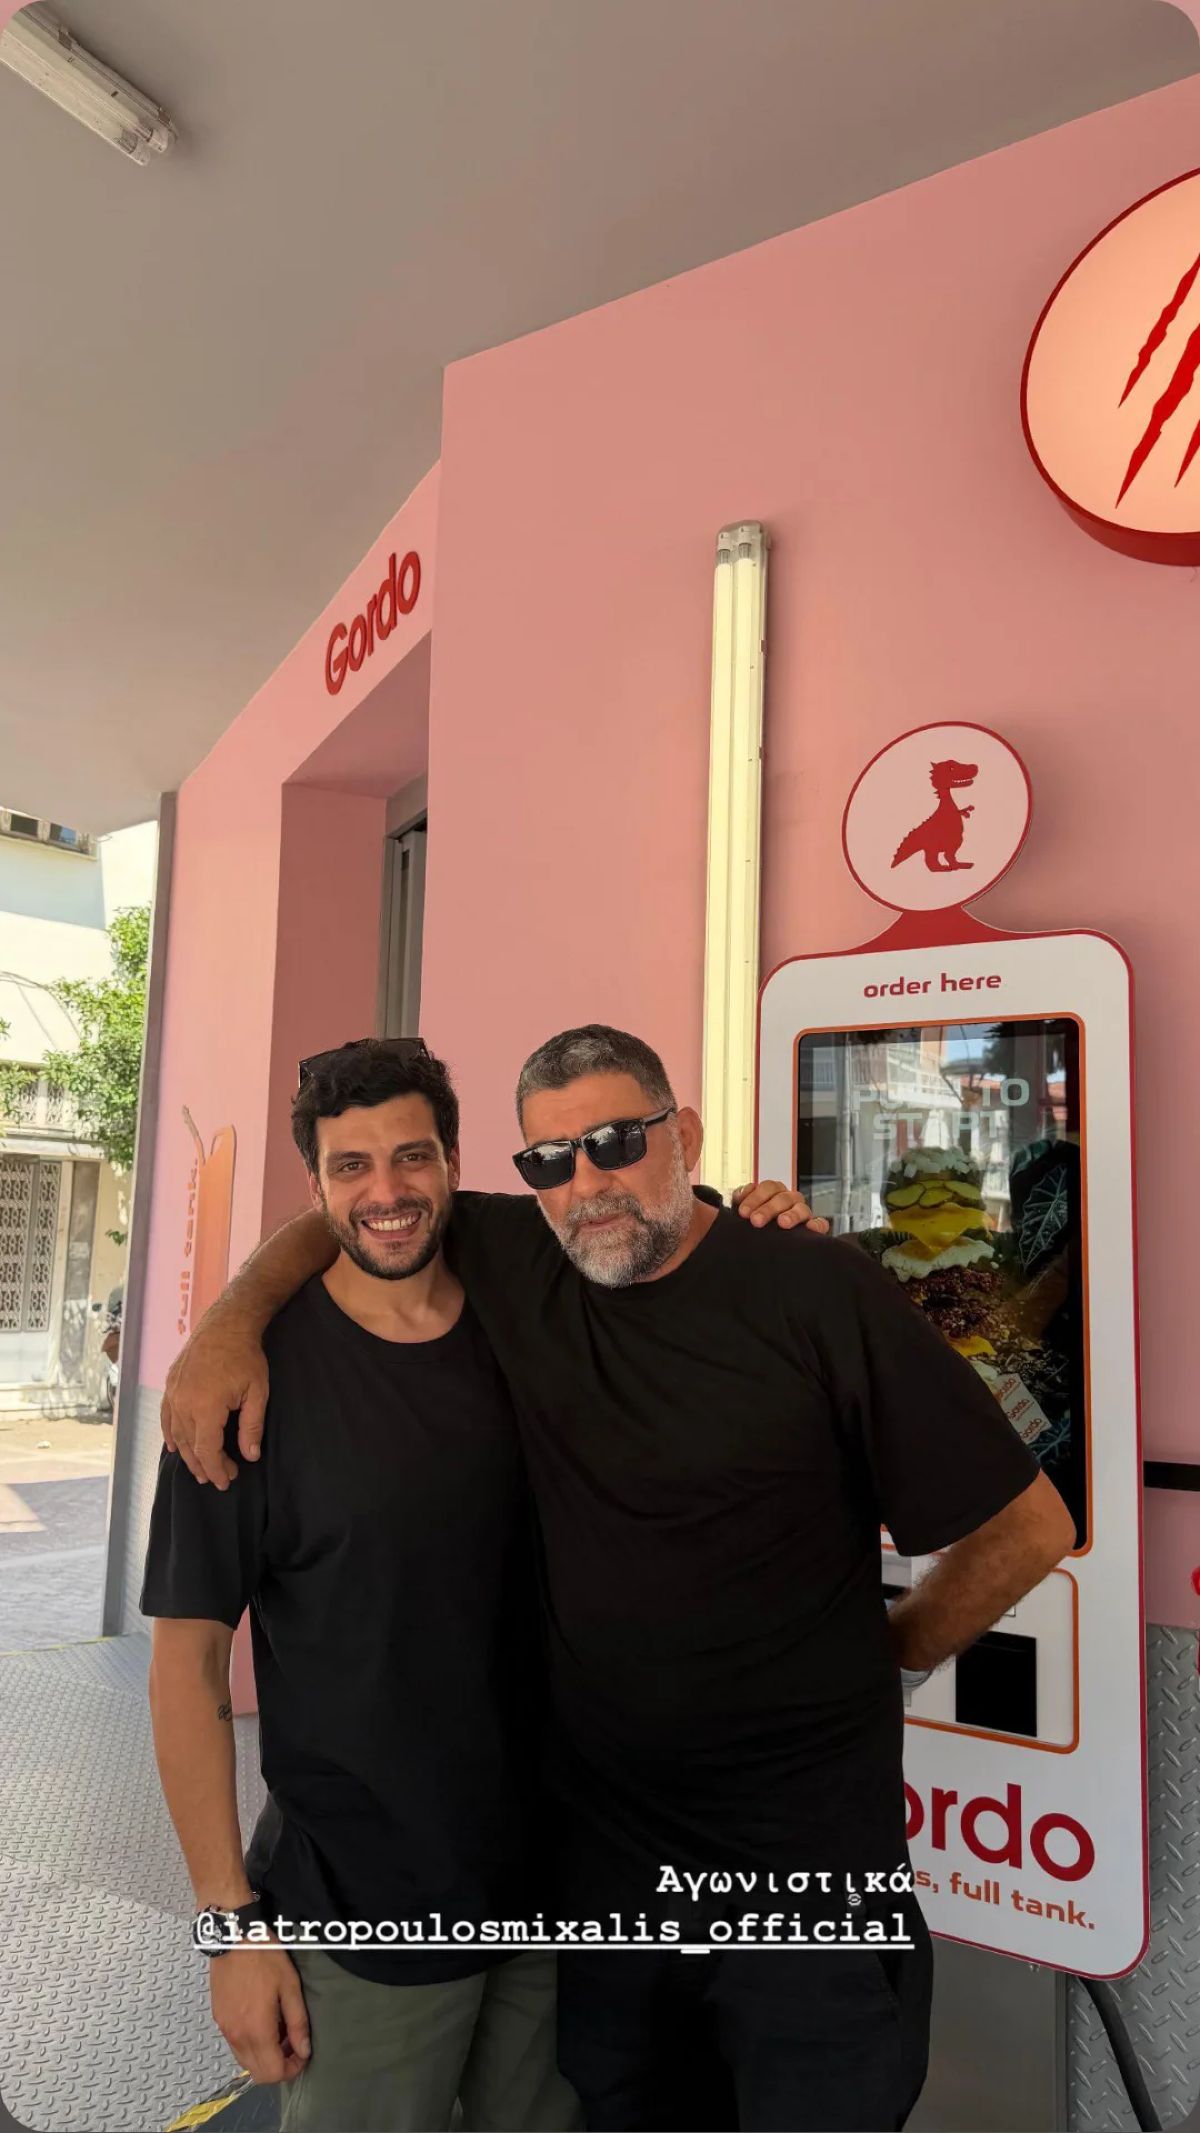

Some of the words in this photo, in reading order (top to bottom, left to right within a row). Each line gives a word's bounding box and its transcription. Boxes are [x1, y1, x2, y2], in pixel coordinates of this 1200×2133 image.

[325, 551, 421, 696] Gordo
[863, 976, 932, 998] order
[940, 972, 1002, 992] here
[872, 1111, 1006, 1141] STRT
[904, 1780, 1095, 1882] rdo
[950, 1871, 1000, 1906] full
[1011, 1889, 1095, 1930] tank.
